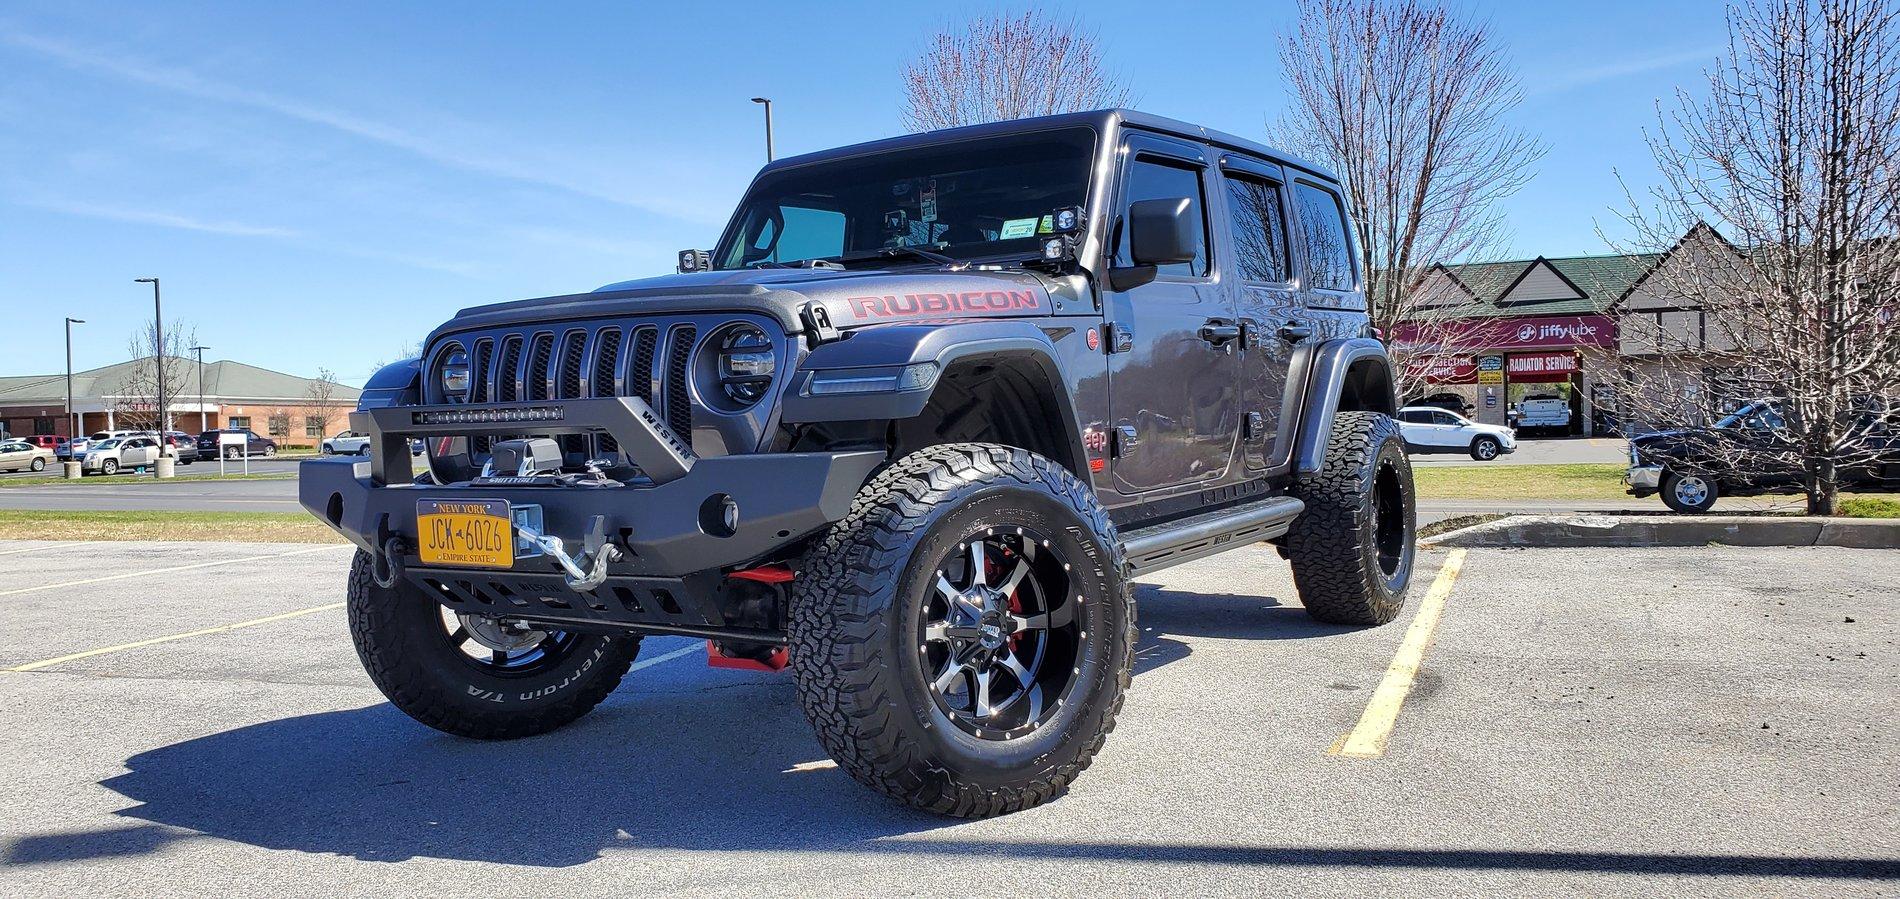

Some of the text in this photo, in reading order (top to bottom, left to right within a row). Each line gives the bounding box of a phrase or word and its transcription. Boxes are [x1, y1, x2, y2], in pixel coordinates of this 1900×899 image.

[848, 289, 1039, 319] RUBICON
[1509, 357, 1544, 372] RADIATOR
[1546, 356, 1576, 371] SERVICE
[641, 410, 691, 460] WESTIN
[1083, 431, 1107, 452] eep
[439, 504, 487, 514] NEW YORK
[429, 518, 502, 552] JCK 6026
[443, 552, 491, 563] EMPIRE STATE
[467, 684, 505, 703] T/A
